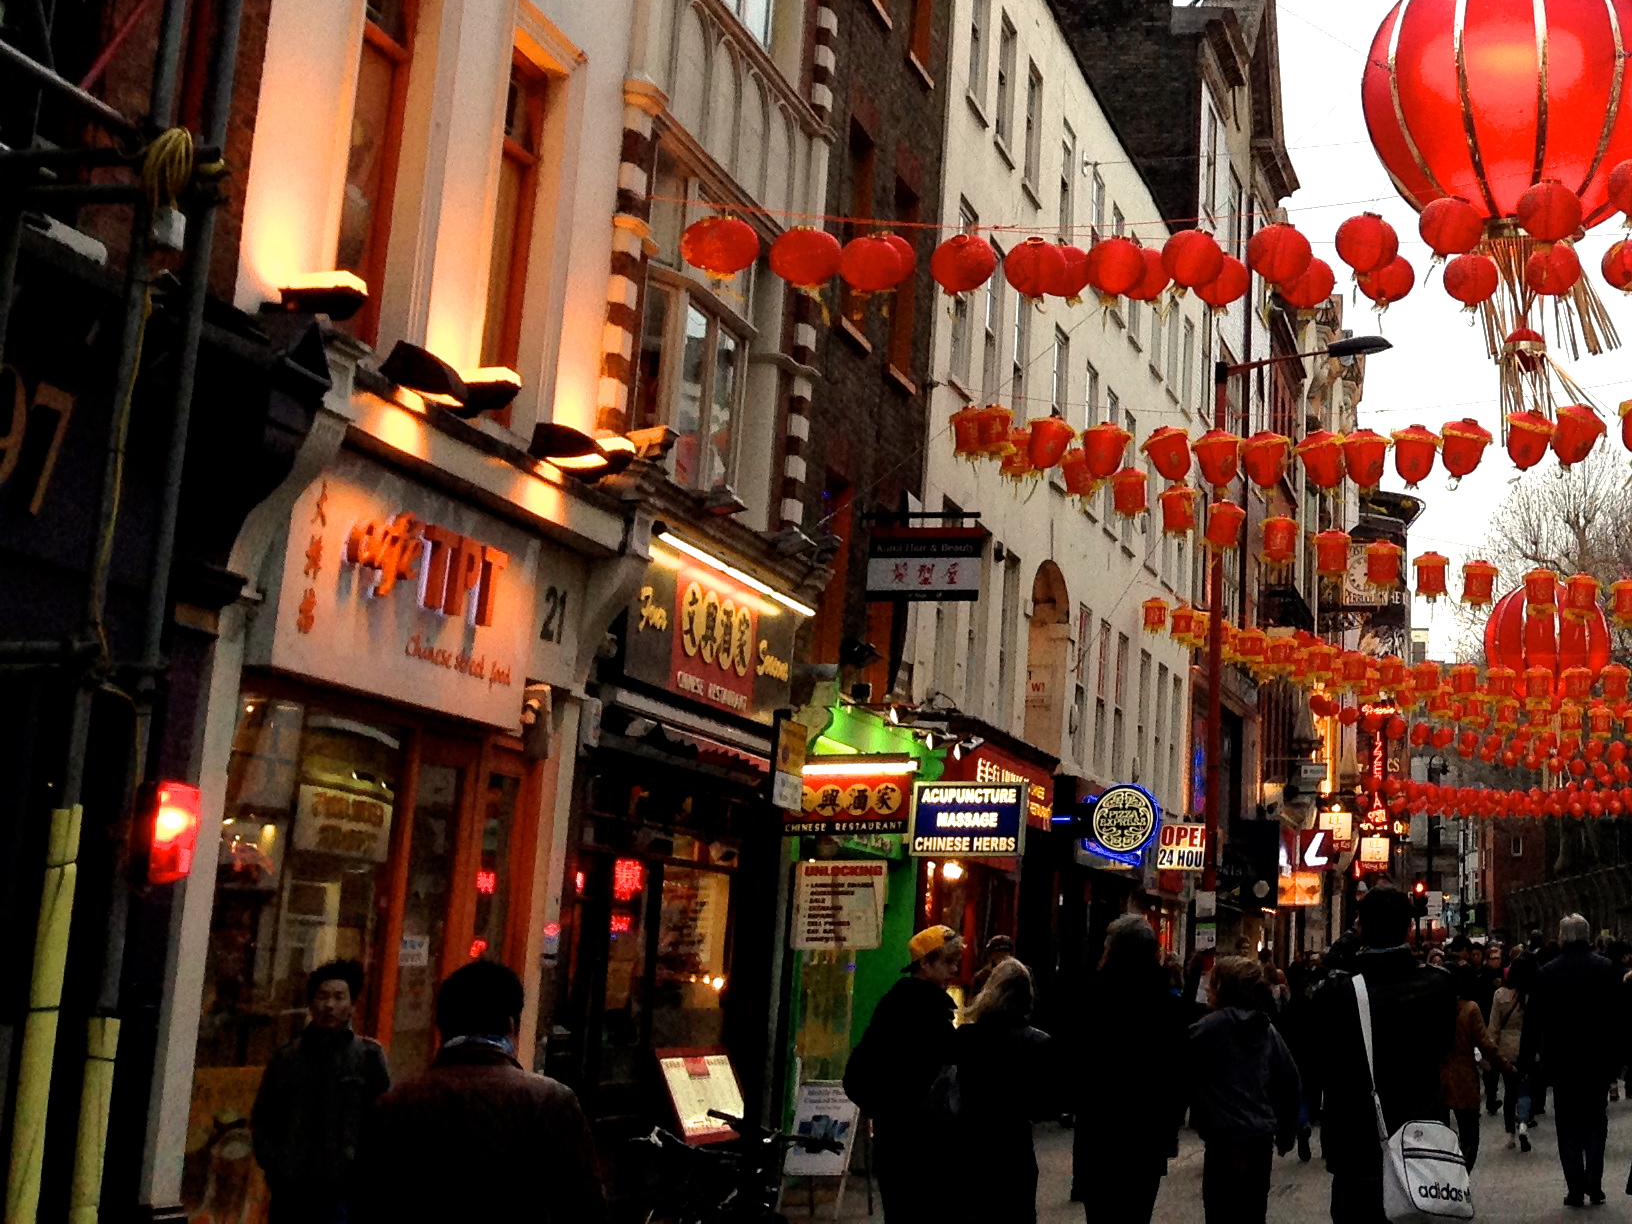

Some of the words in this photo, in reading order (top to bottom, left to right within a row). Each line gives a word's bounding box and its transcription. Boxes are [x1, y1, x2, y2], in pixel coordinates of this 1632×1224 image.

[418, 524, 510, 628] TPT
[540, 586, 567, 645] 21
[488, 660, 513, 693] food
[678, 671, 704, 696] CHINESE
[921, 788, 1017, 804] ACUPUNCTURE
[936, 812, 998, 828] MASSAGE
[1109, 810, 1138, 818] PIZZA
[784, 823, 827, 832] CHINESE
[834, 821, 903, 832] RESTAURANT
[914, 837, 970, 852] CHINESE
[972, 837, 1016, 852] HERBS
[1158, 849, 1174, 866] 24
[1176, 849, 1203, 867] HOU
[804, 865, 883, 876] UNLOCKING
[1418, 1181, 1465, 1203] adidas
